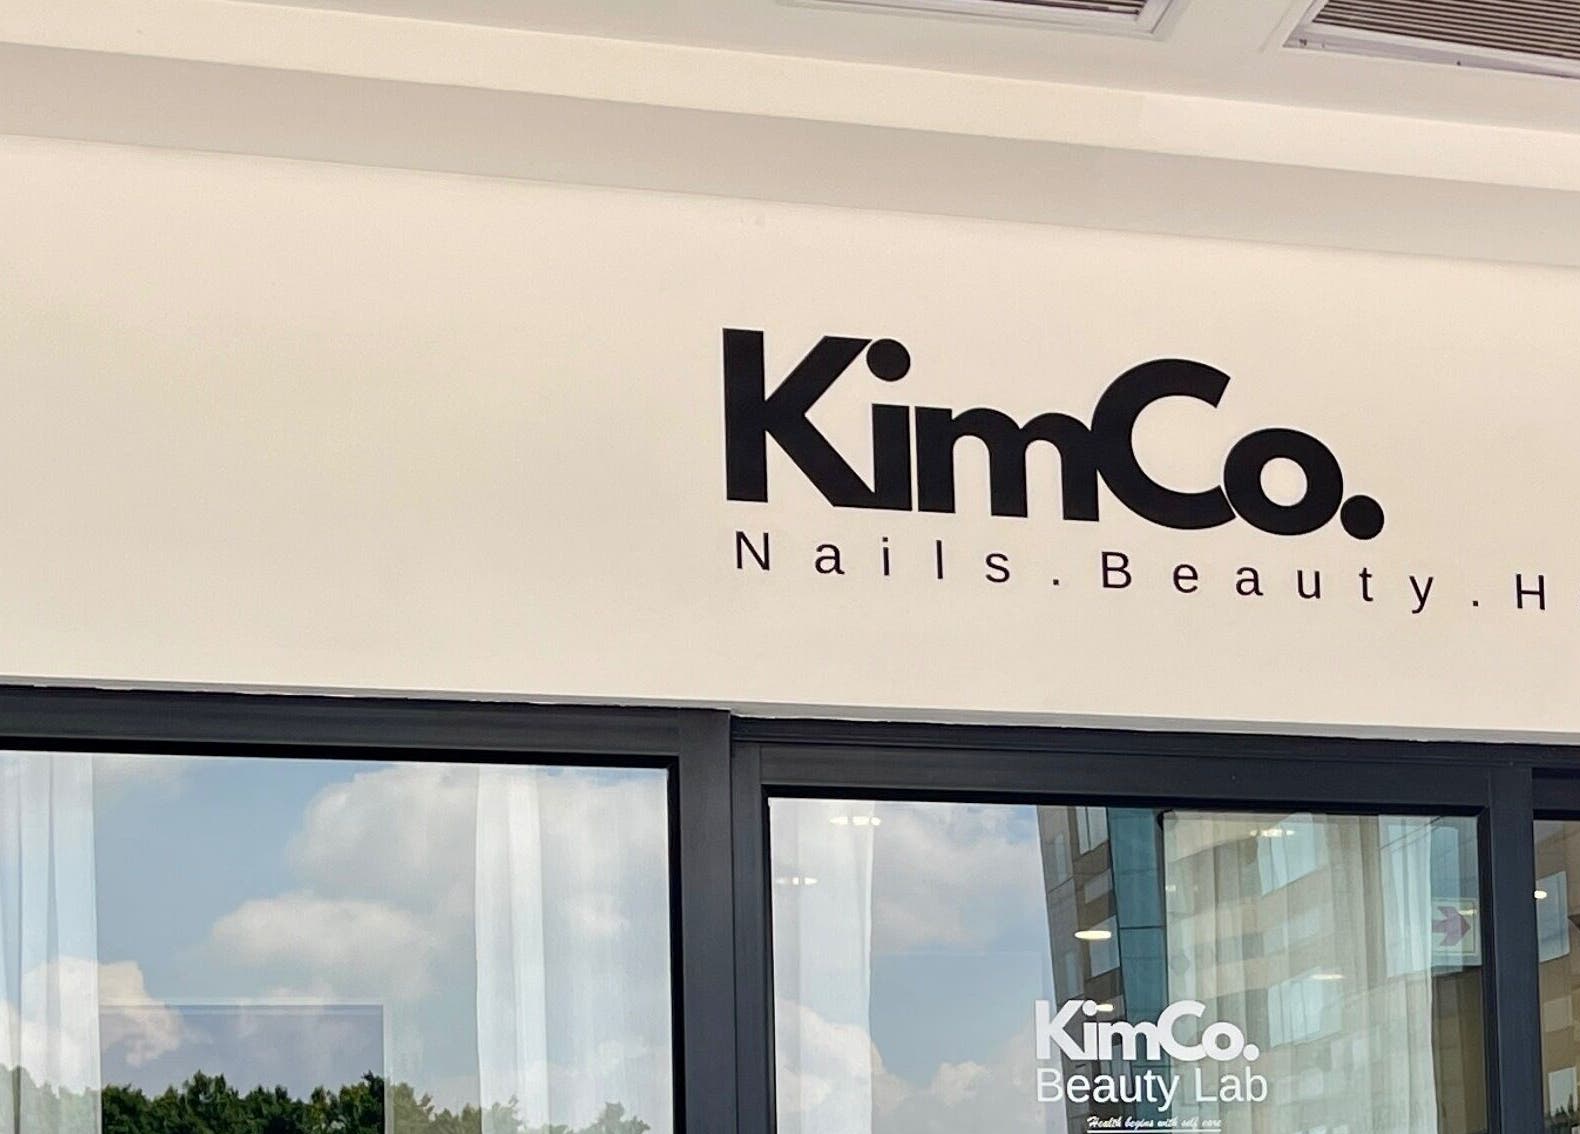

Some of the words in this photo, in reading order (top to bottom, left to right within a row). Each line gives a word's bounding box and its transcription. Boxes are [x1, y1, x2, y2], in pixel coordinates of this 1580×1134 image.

[722, 327, 1385, 541] KimCo.
[1034, 999, 1260, 1062] KimCo.
[1036, 1067, 1180, 1112] Beauty
[1194, 1066, 1269, 1102] Lab
[1087, 1115, 1122, 1128] Health
[1124, 1116, 1155, 1131] begins
[1157, 1117, 1179, 1128] with
